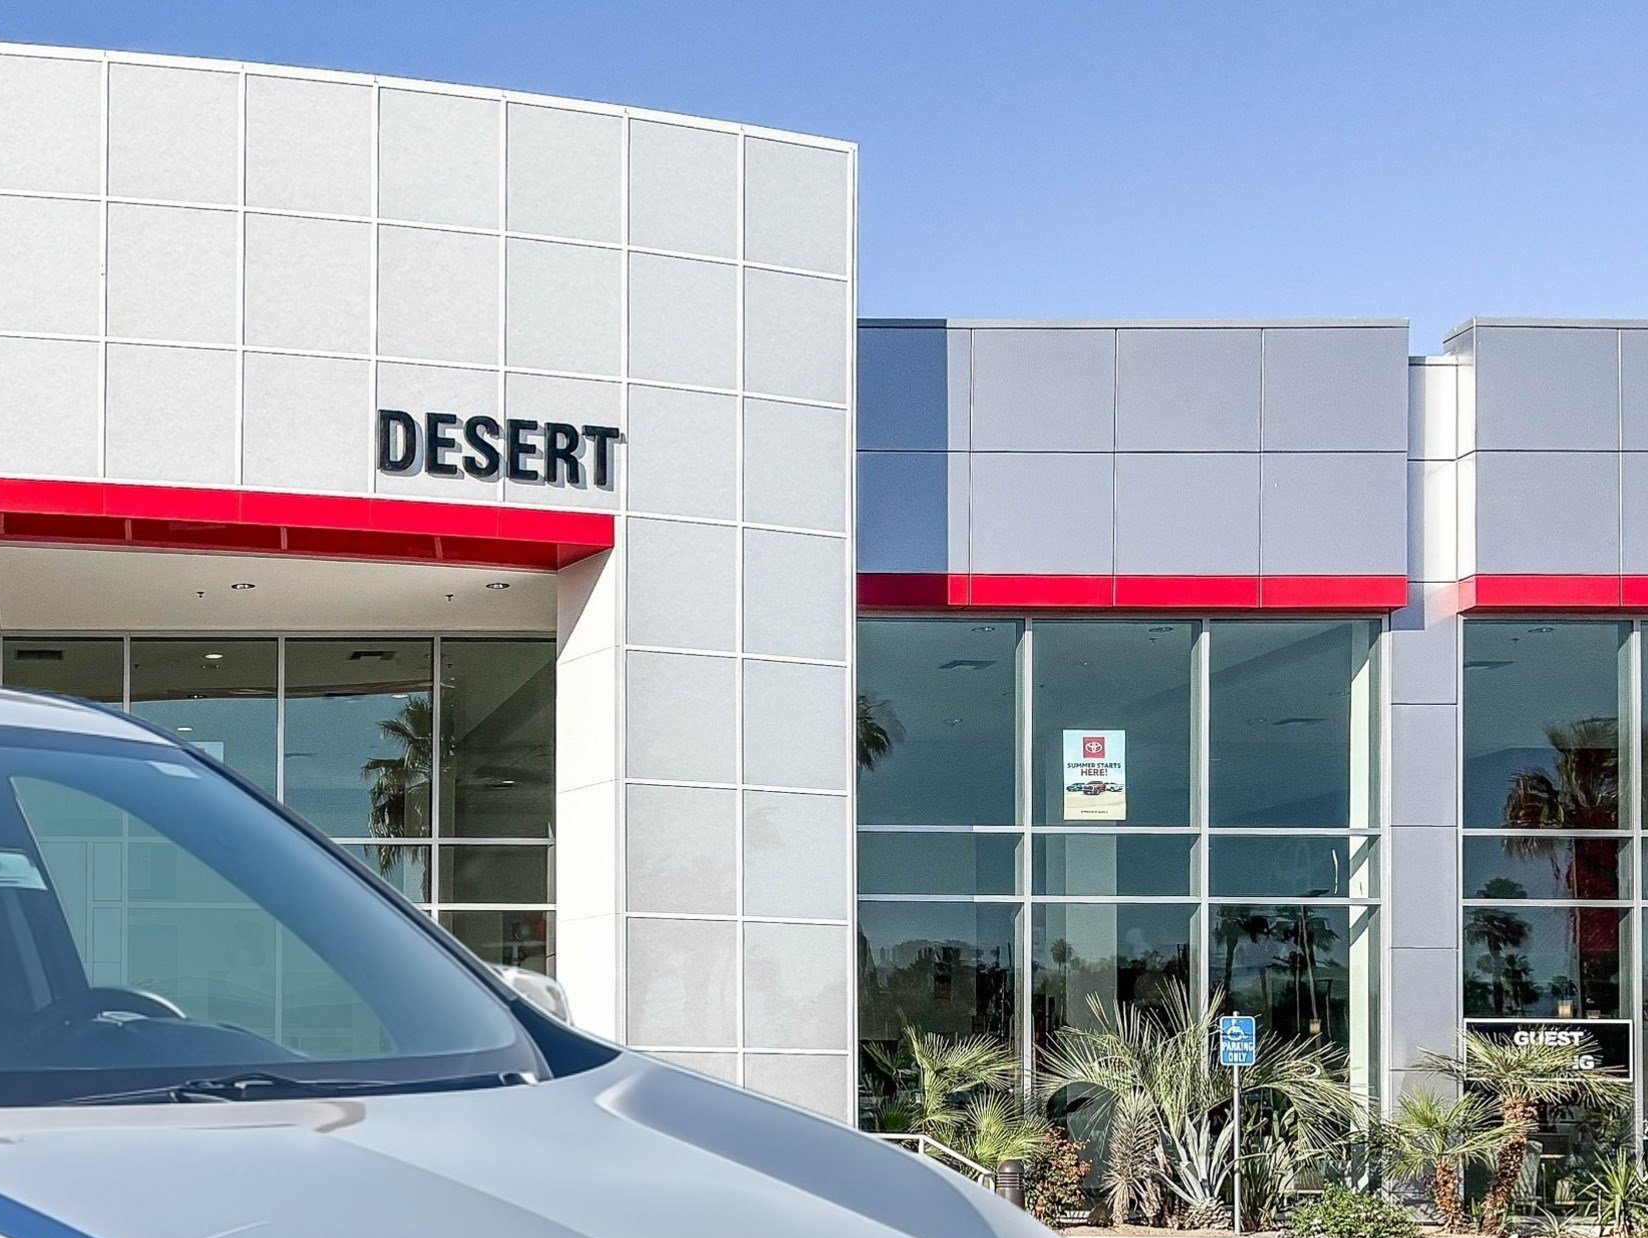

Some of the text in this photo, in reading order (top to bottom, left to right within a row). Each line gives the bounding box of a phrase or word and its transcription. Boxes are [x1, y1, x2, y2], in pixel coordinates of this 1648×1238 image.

[376, 408, 621, 487] DESERT
[1080, 768, 1108, 776] HERE!
[1513, 1030, 1584, 1046] GUEST
[1222, 1041, 1254, 1051] PARKING
[1228, 1051, 1248, 1062] ONLY
